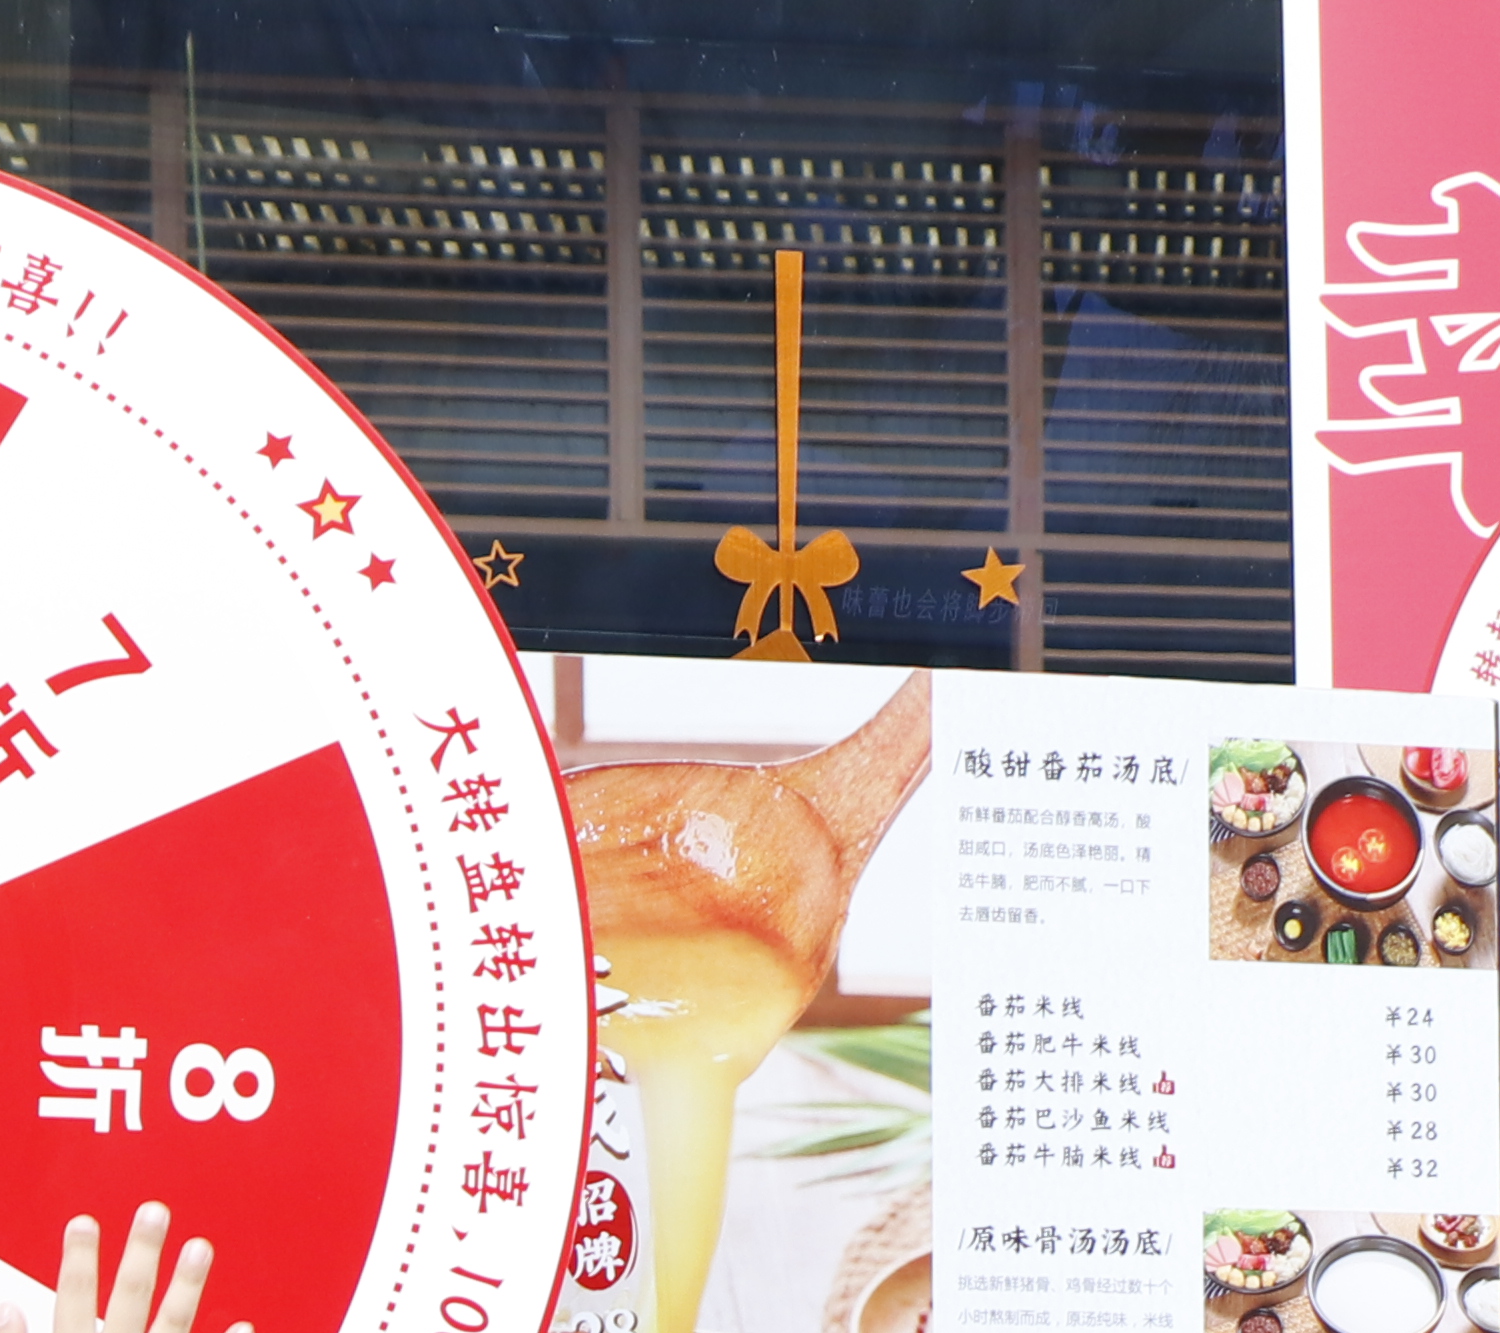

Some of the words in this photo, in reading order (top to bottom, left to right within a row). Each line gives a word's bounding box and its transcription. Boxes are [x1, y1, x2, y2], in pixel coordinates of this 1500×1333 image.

[977, 992, 1084, 1020] 番茄米线
[977, 1030, 1141, 1059] 番茄肥牛米线
[37, 1022, 275, 1138] 8折
[977, 1067, 1142, 1096] 番茄大排米线
[978, 1104, 1170, 1134] 番茄巴沙鱼米线
[978, 1141, 1142, 1170] 番茄牛腩米线
[576, 1178, 624, 1281] 招牌
